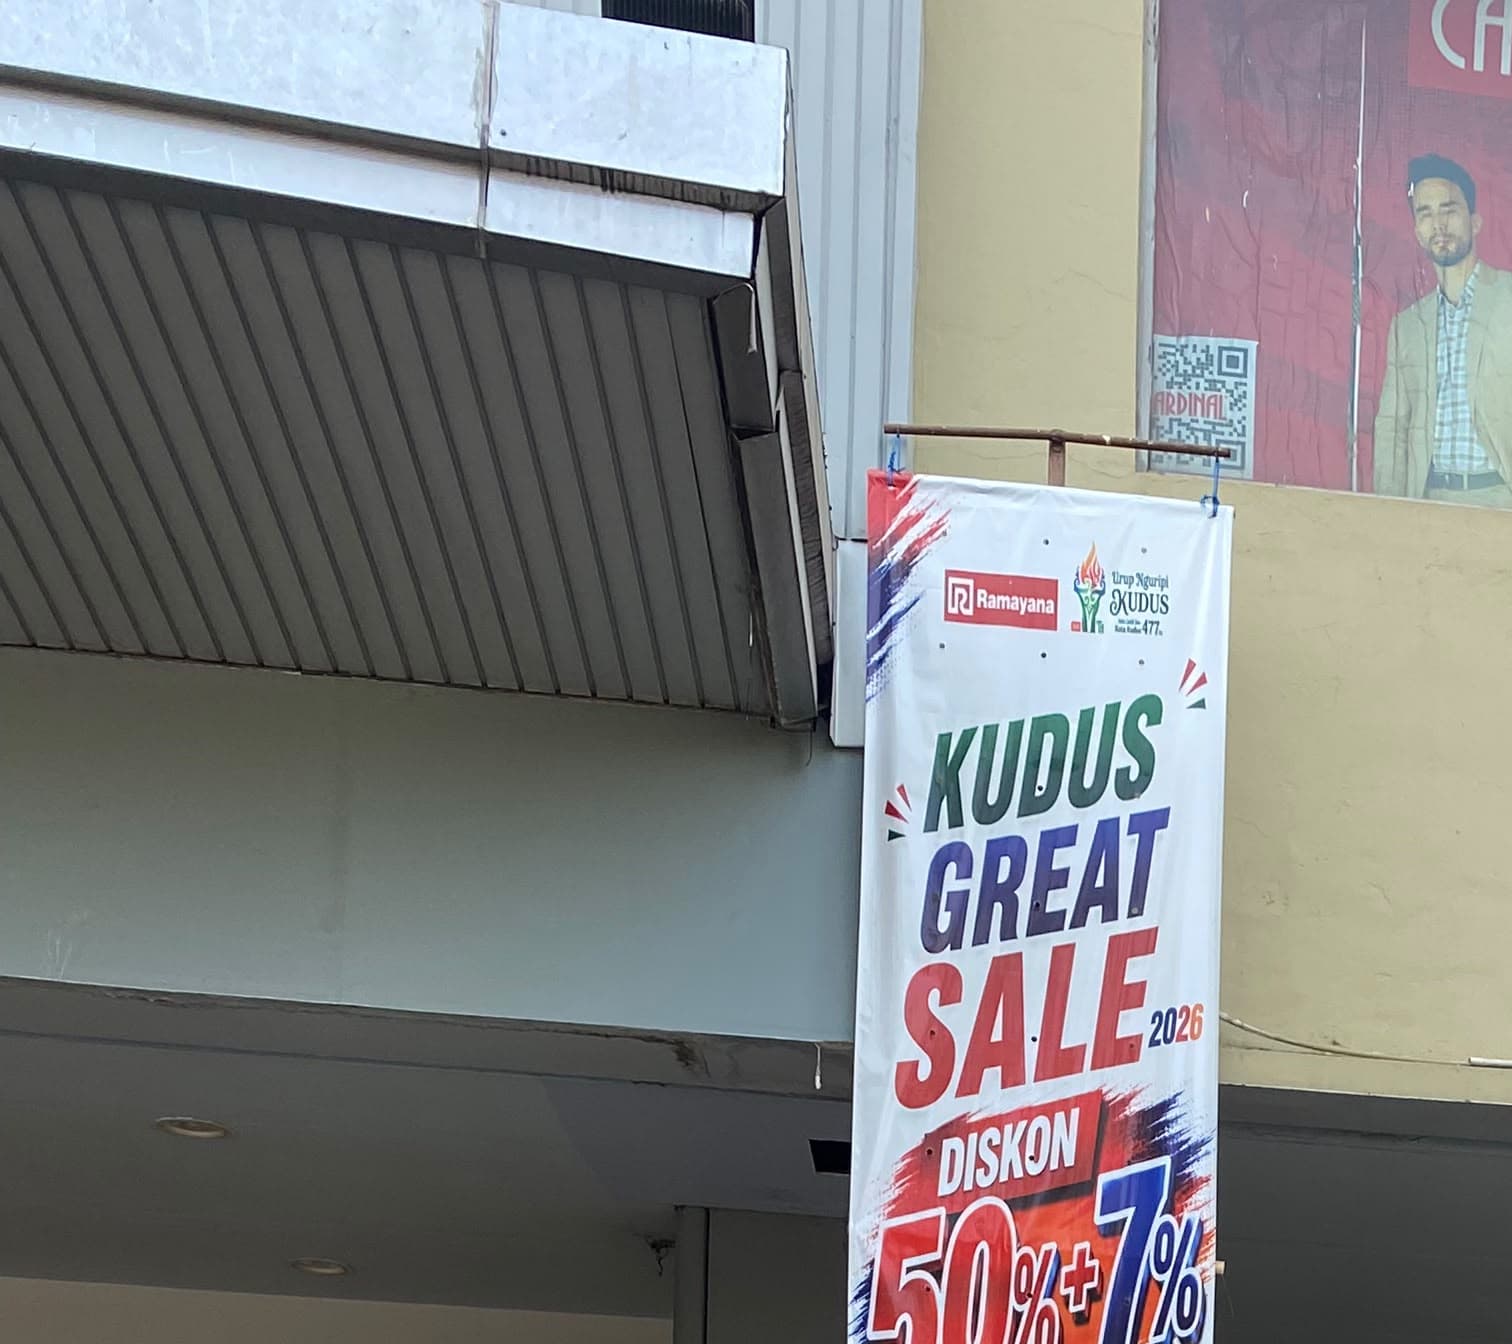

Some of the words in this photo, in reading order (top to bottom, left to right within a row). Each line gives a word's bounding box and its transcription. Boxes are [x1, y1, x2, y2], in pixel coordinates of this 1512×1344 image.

[1152, 391, 1227, 421] ARDINAL
[977, 589, 1055, 615] Ramayana
[1109, 588, 1169, 616] KUDUS
[923, 694, 1164, 834] KUDUS
[920, 807, 1171, 954] GREAT
[895, 926, 1160, 1109] SALE
[1148, 1003, 1204, 1049] 2026
[938, 1107, 1080, 1198] DISKON
